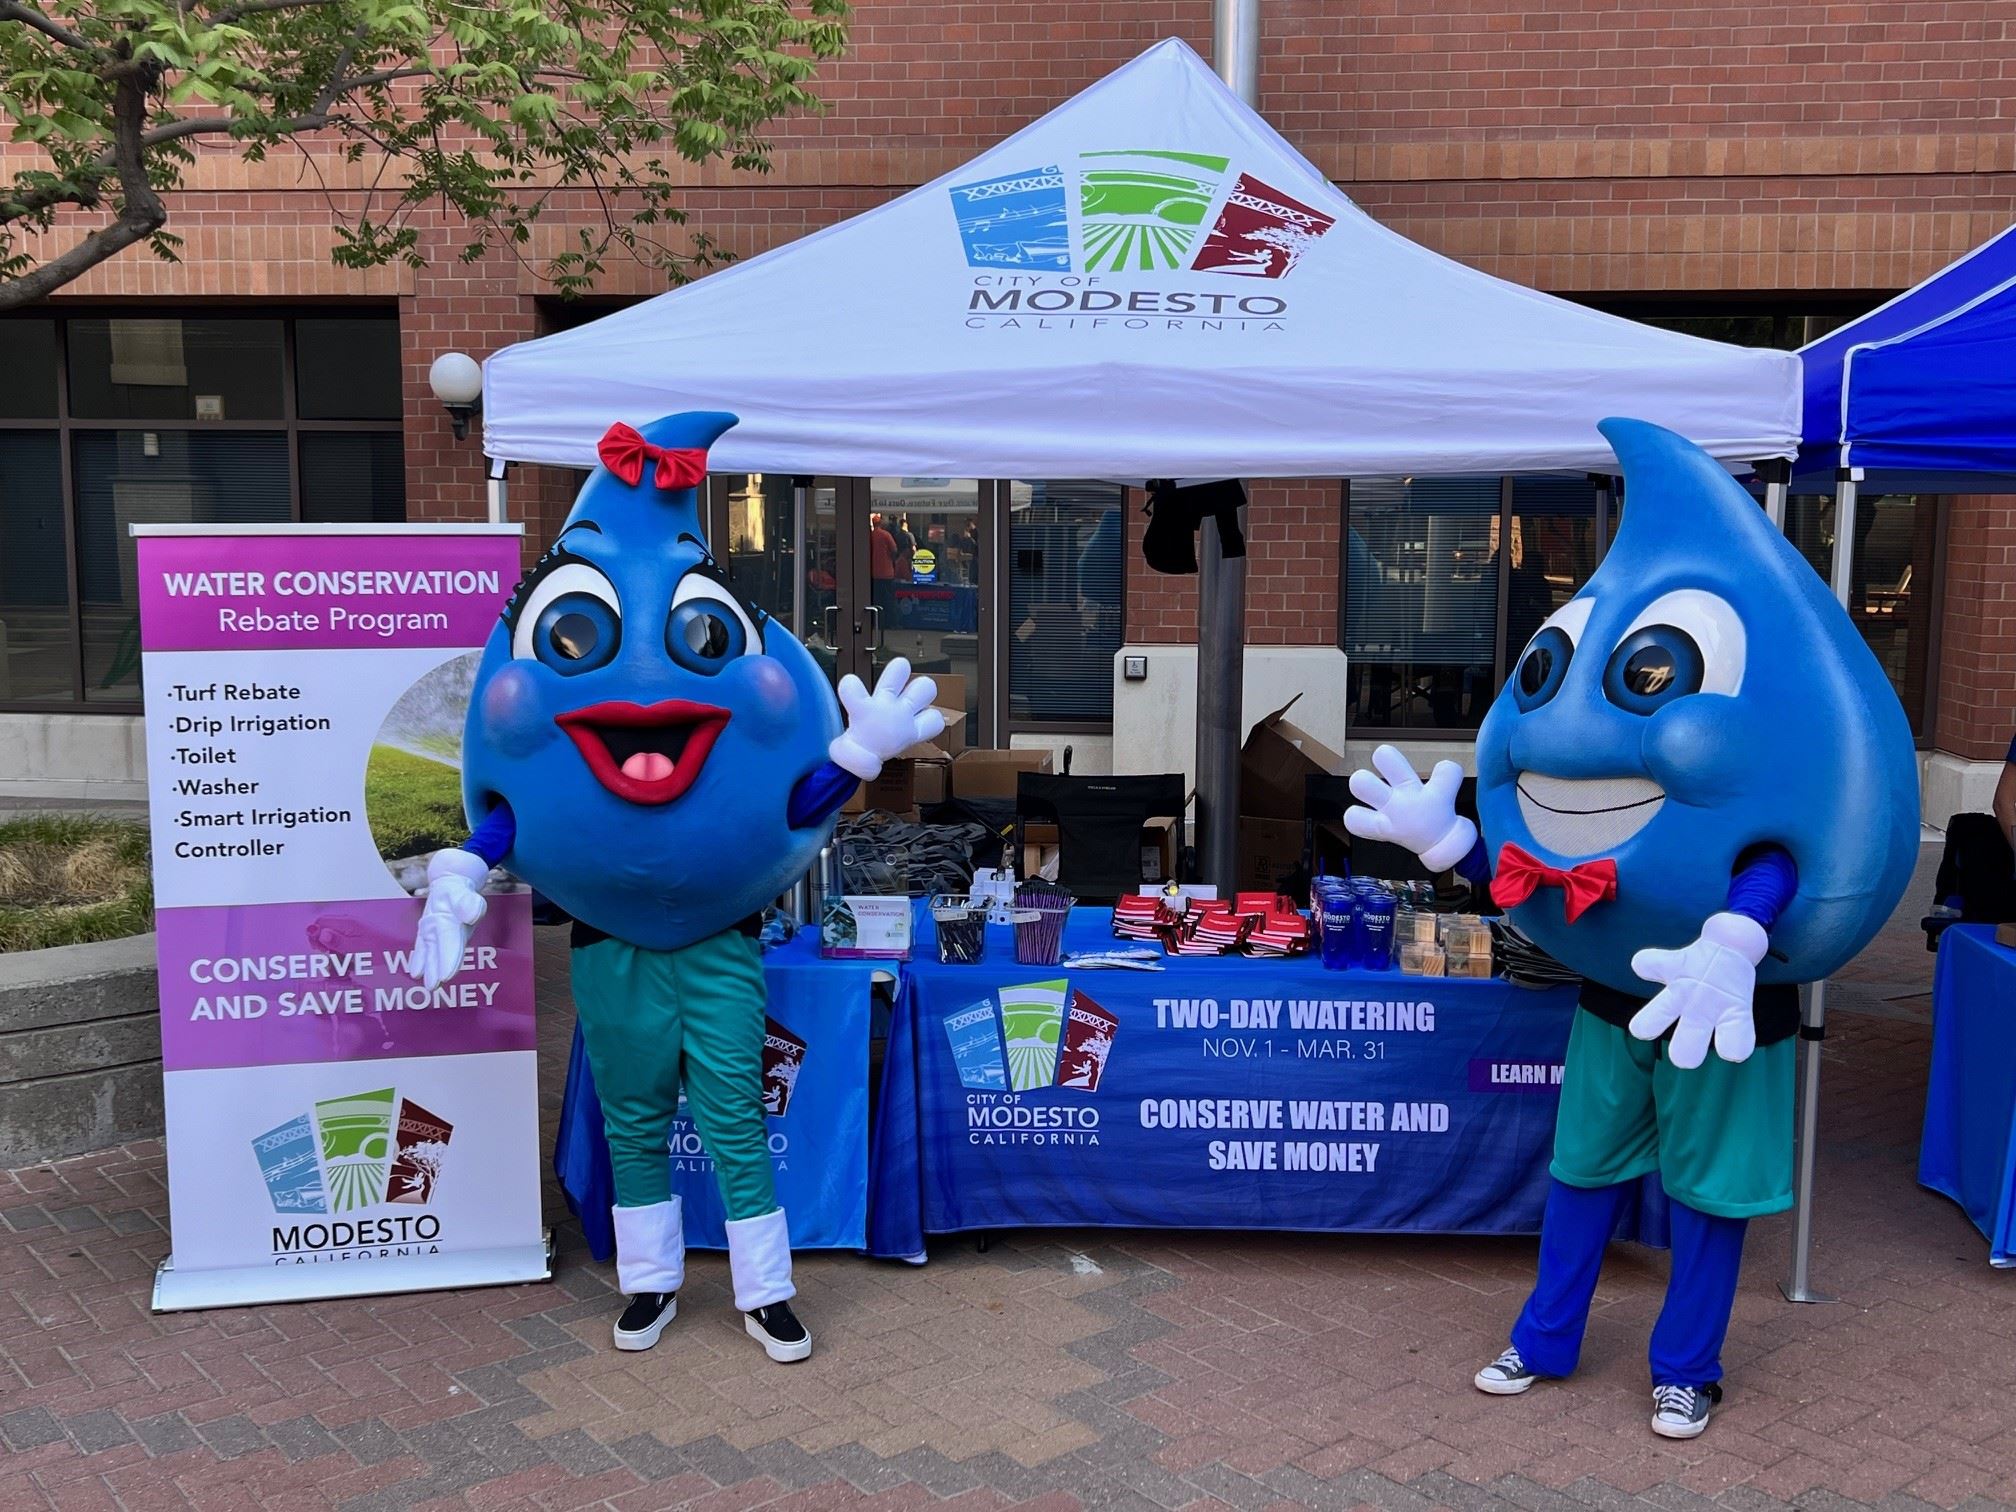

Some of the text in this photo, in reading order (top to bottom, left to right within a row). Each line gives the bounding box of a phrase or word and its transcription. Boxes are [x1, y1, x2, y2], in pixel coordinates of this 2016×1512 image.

[974, 276, 1101, 287] CITY OF
[968, 289, 1288, 315] MODESTO
[965, 317, 1286, 332] CALIFORNIA
[163, 570, 500, 597] WATER CONSERVATION
[219, 606, 448, 637] Rebate Program
[224, 683, 301, 701] Rebate
[231, 715, 330, 735] Irrigation
[251, 807, 351, 828] Irrigation
[174, 839, 285, 859] Controller
[189, 946, 498, 985] CONSERVE WER
[190, 982, 501, 1021] AND SAVE MONEY
[1153, 998, 1436, 1032] TWO-DAY WATERING
[1203, 1038, 1259, 1059] NOV.
[1264, 1039, 1273, 1058] 1
[1298, 1039, 1357, 1059] MAR.
[1363, 1040, 1385, 1060] 31
[1491, 1064, 1546, 1084] LEARN
[966, 1093, 1022, 1105] CITY OF
[967, 1106, 1100, 1128] MODESTO
[1140, 1099, 1449, 1133] CONSERVE WATER AND
[969, 1133, 1100, 1146] CALIFORNIA
[1208, 1141, 1380, 1173] SAVE MONEY
[272, 1214, 441, 1252] MODESTO
